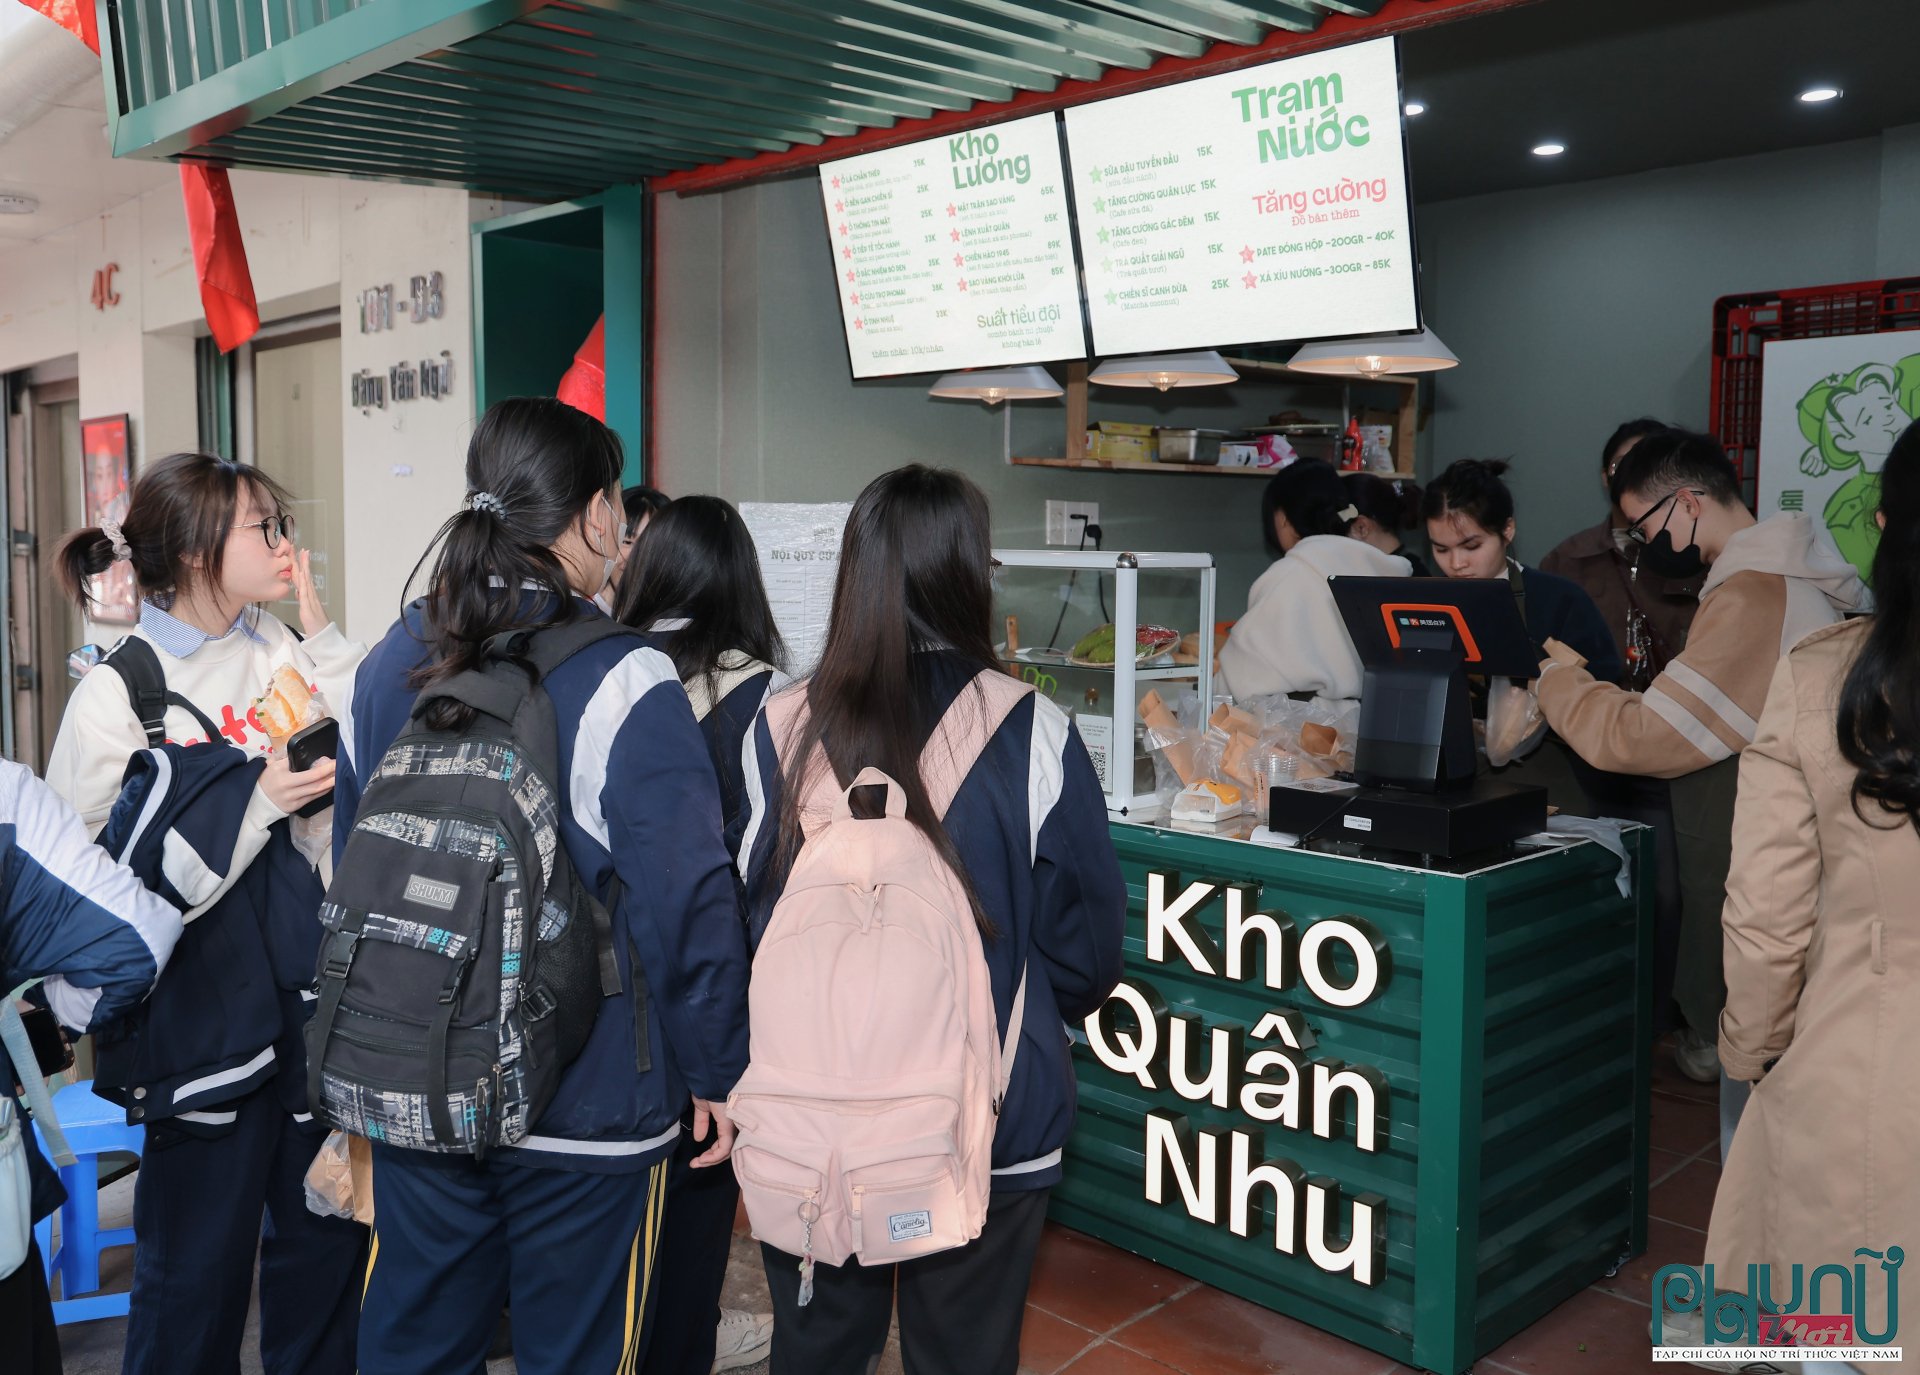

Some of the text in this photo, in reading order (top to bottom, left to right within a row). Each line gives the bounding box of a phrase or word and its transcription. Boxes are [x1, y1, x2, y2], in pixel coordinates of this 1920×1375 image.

[1258, 107, 1369, 162] Nước
[949, 132, 999, 162] Kho
[1196, 144, 1212, 156] 15K
[953, 155, 1030, 188] Lương
[916, 184, 928, 193] 25K
[1200, 178, 1216, 189] 15K
[1040, 185, 1054, 195] 65K
[1252, 177, 1386, 214] Tăng cường
[859, 196, 871, 204] GAN
[985, 198, 997, 206] SAO
[920, 209, 932, 217] 25K
[1044, 212, 1057, 222] 65K
[1203, 211, 1219, 221] 15K
[1308, 212, 1328, 223] bán
[1330, 208, 1359, 220] thêm
[924, 233, 936, 242] 33K
[1256, 246, 1276, 256] PATE
[1278, 242, 1302, 253] ĐÓNG
[1304, 238, 1323, 251] HỘP
[1374, 229, 1394, 240] 40K
[1047, 239, 1060, 248] 89K
[1207, 243, 1223, 253] 15K
[996, 248, 1009, 256] 1945
[928, 258, 939, 266] 35K
[1372, 258, 1390, 269] 85K
[91, 262, 120, 310] 4C
[968, 278, 980, 286] SAO
[1211, 278, 1229, 289] 25K
[1149, 286, 1170, 295] CANH
[357, 283, 393, 334] 101
[935, 309, 947, 317] 33K
[976, 303, 1060, 328] Suất tiểu đội
[793, 550, 816, 562] QUY
[408, 881, 454, 904] SHUNYI
[1146, 870, 1380, 1008] Kho
[1083, 981, 1377, 1153] Quân
[1144, 1111, 1374, 1287] Nhu
